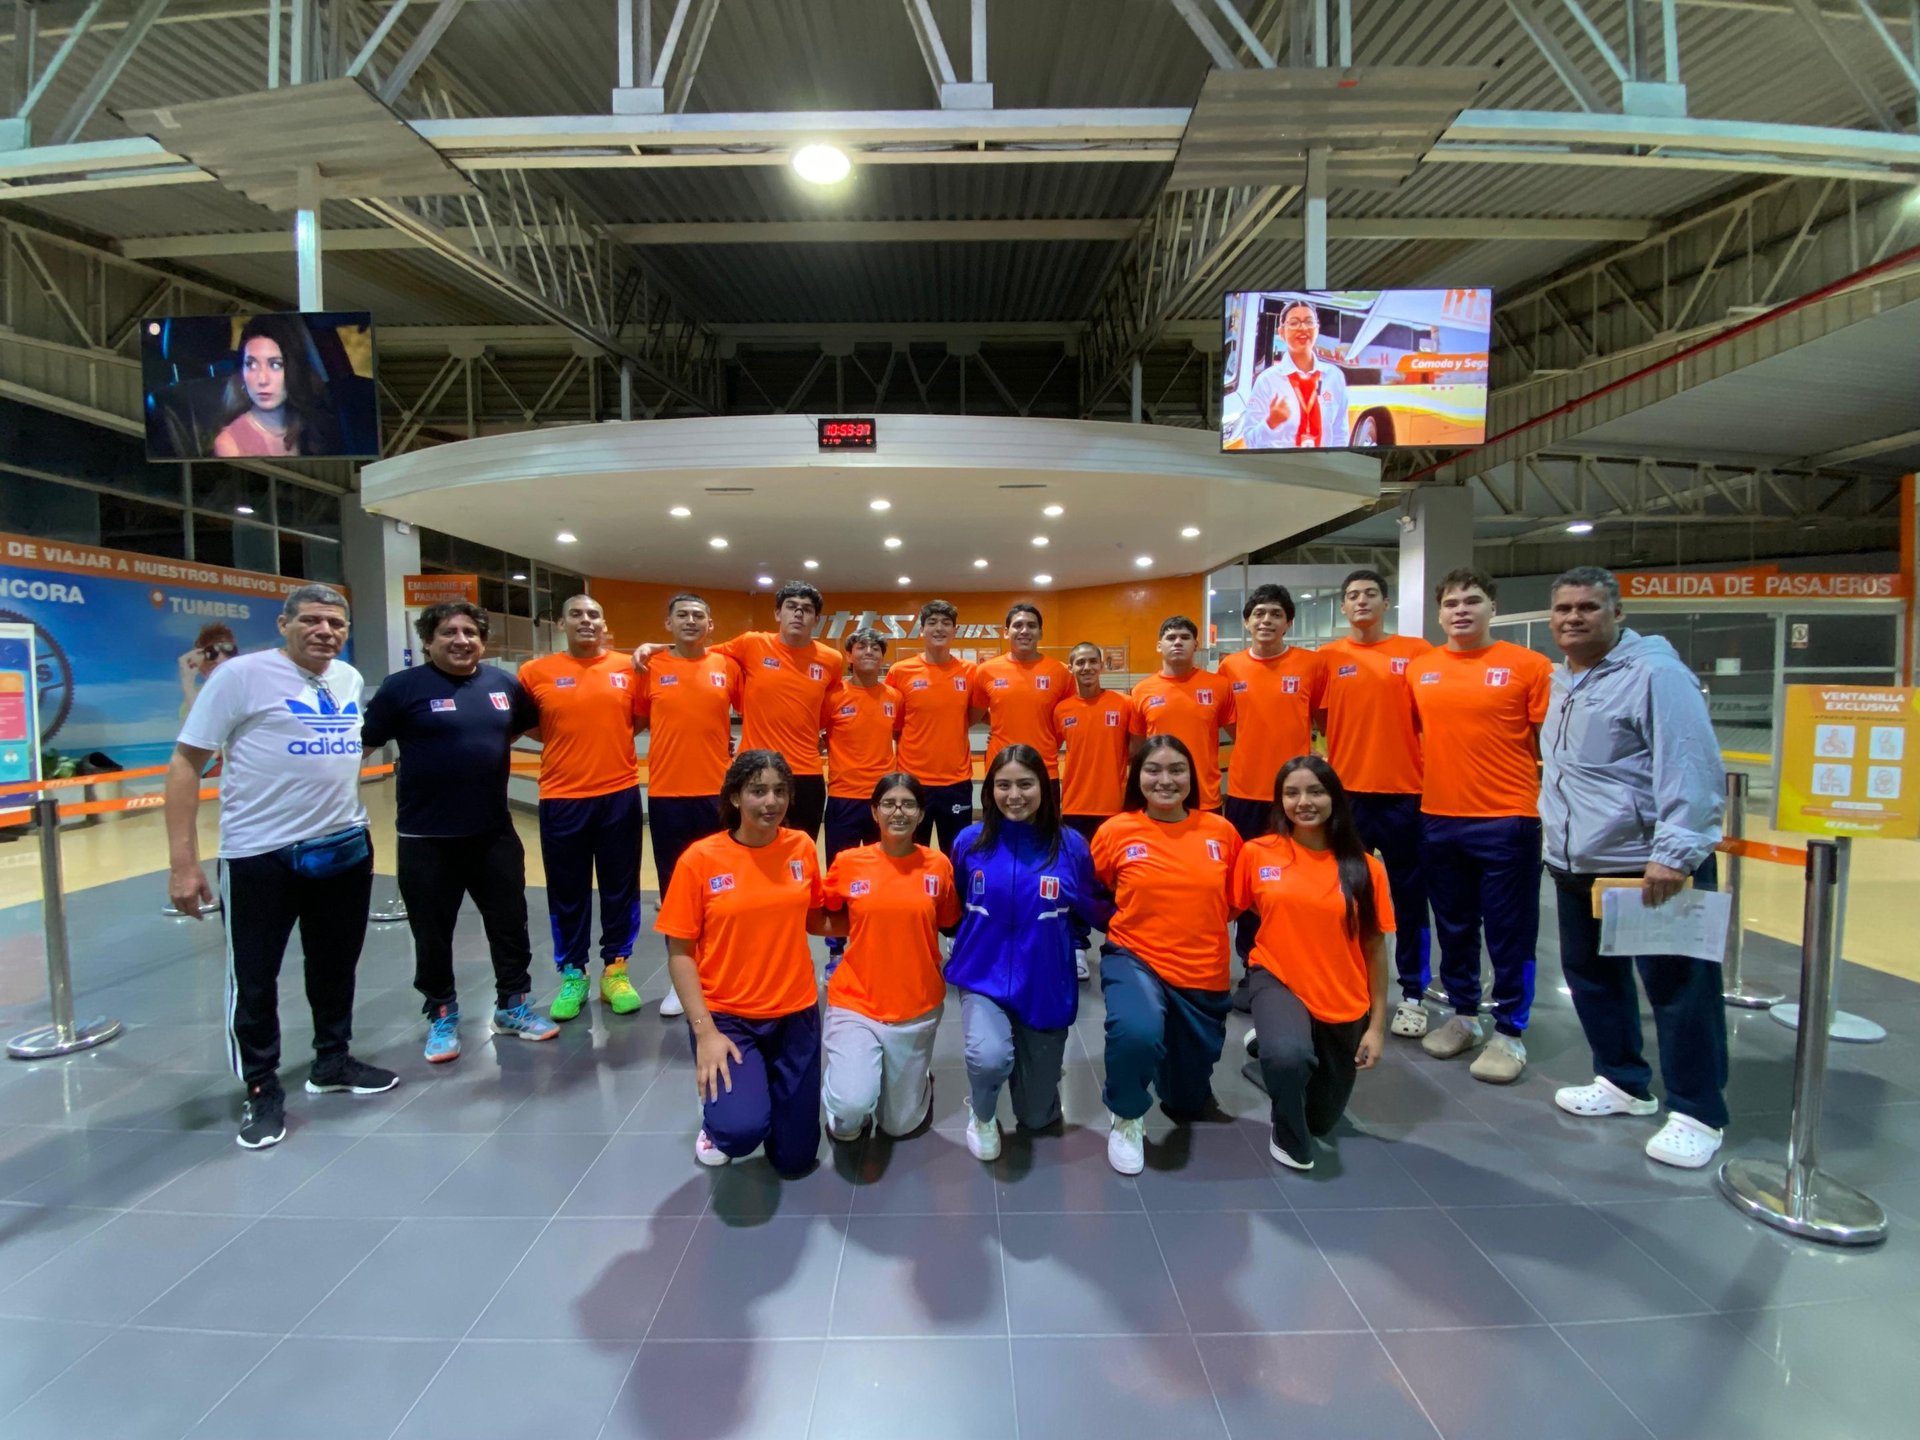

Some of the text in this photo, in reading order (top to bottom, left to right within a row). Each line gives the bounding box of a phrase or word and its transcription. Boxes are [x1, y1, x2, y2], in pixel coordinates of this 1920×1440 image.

[1455, 361, 1462, 371] y
[8, 541, 37, 559] DE
[43, 547, 113, 569] VIAJAR
[117, 558, 129, 572] A
[133, 560, 219, 584] NUESTROS
[222, 573, 277, 593] NUEVOS
[1630, 576, 1892, 596] SALIDA DE PASAJEROS
[169, 597, 250, 620] TUMBES
[1821, 691, 1905, 703] VENTANILLA
[1825, 702, 1900, 713] EXCLUSIVA
[287, 737, 362, 755] adidas
